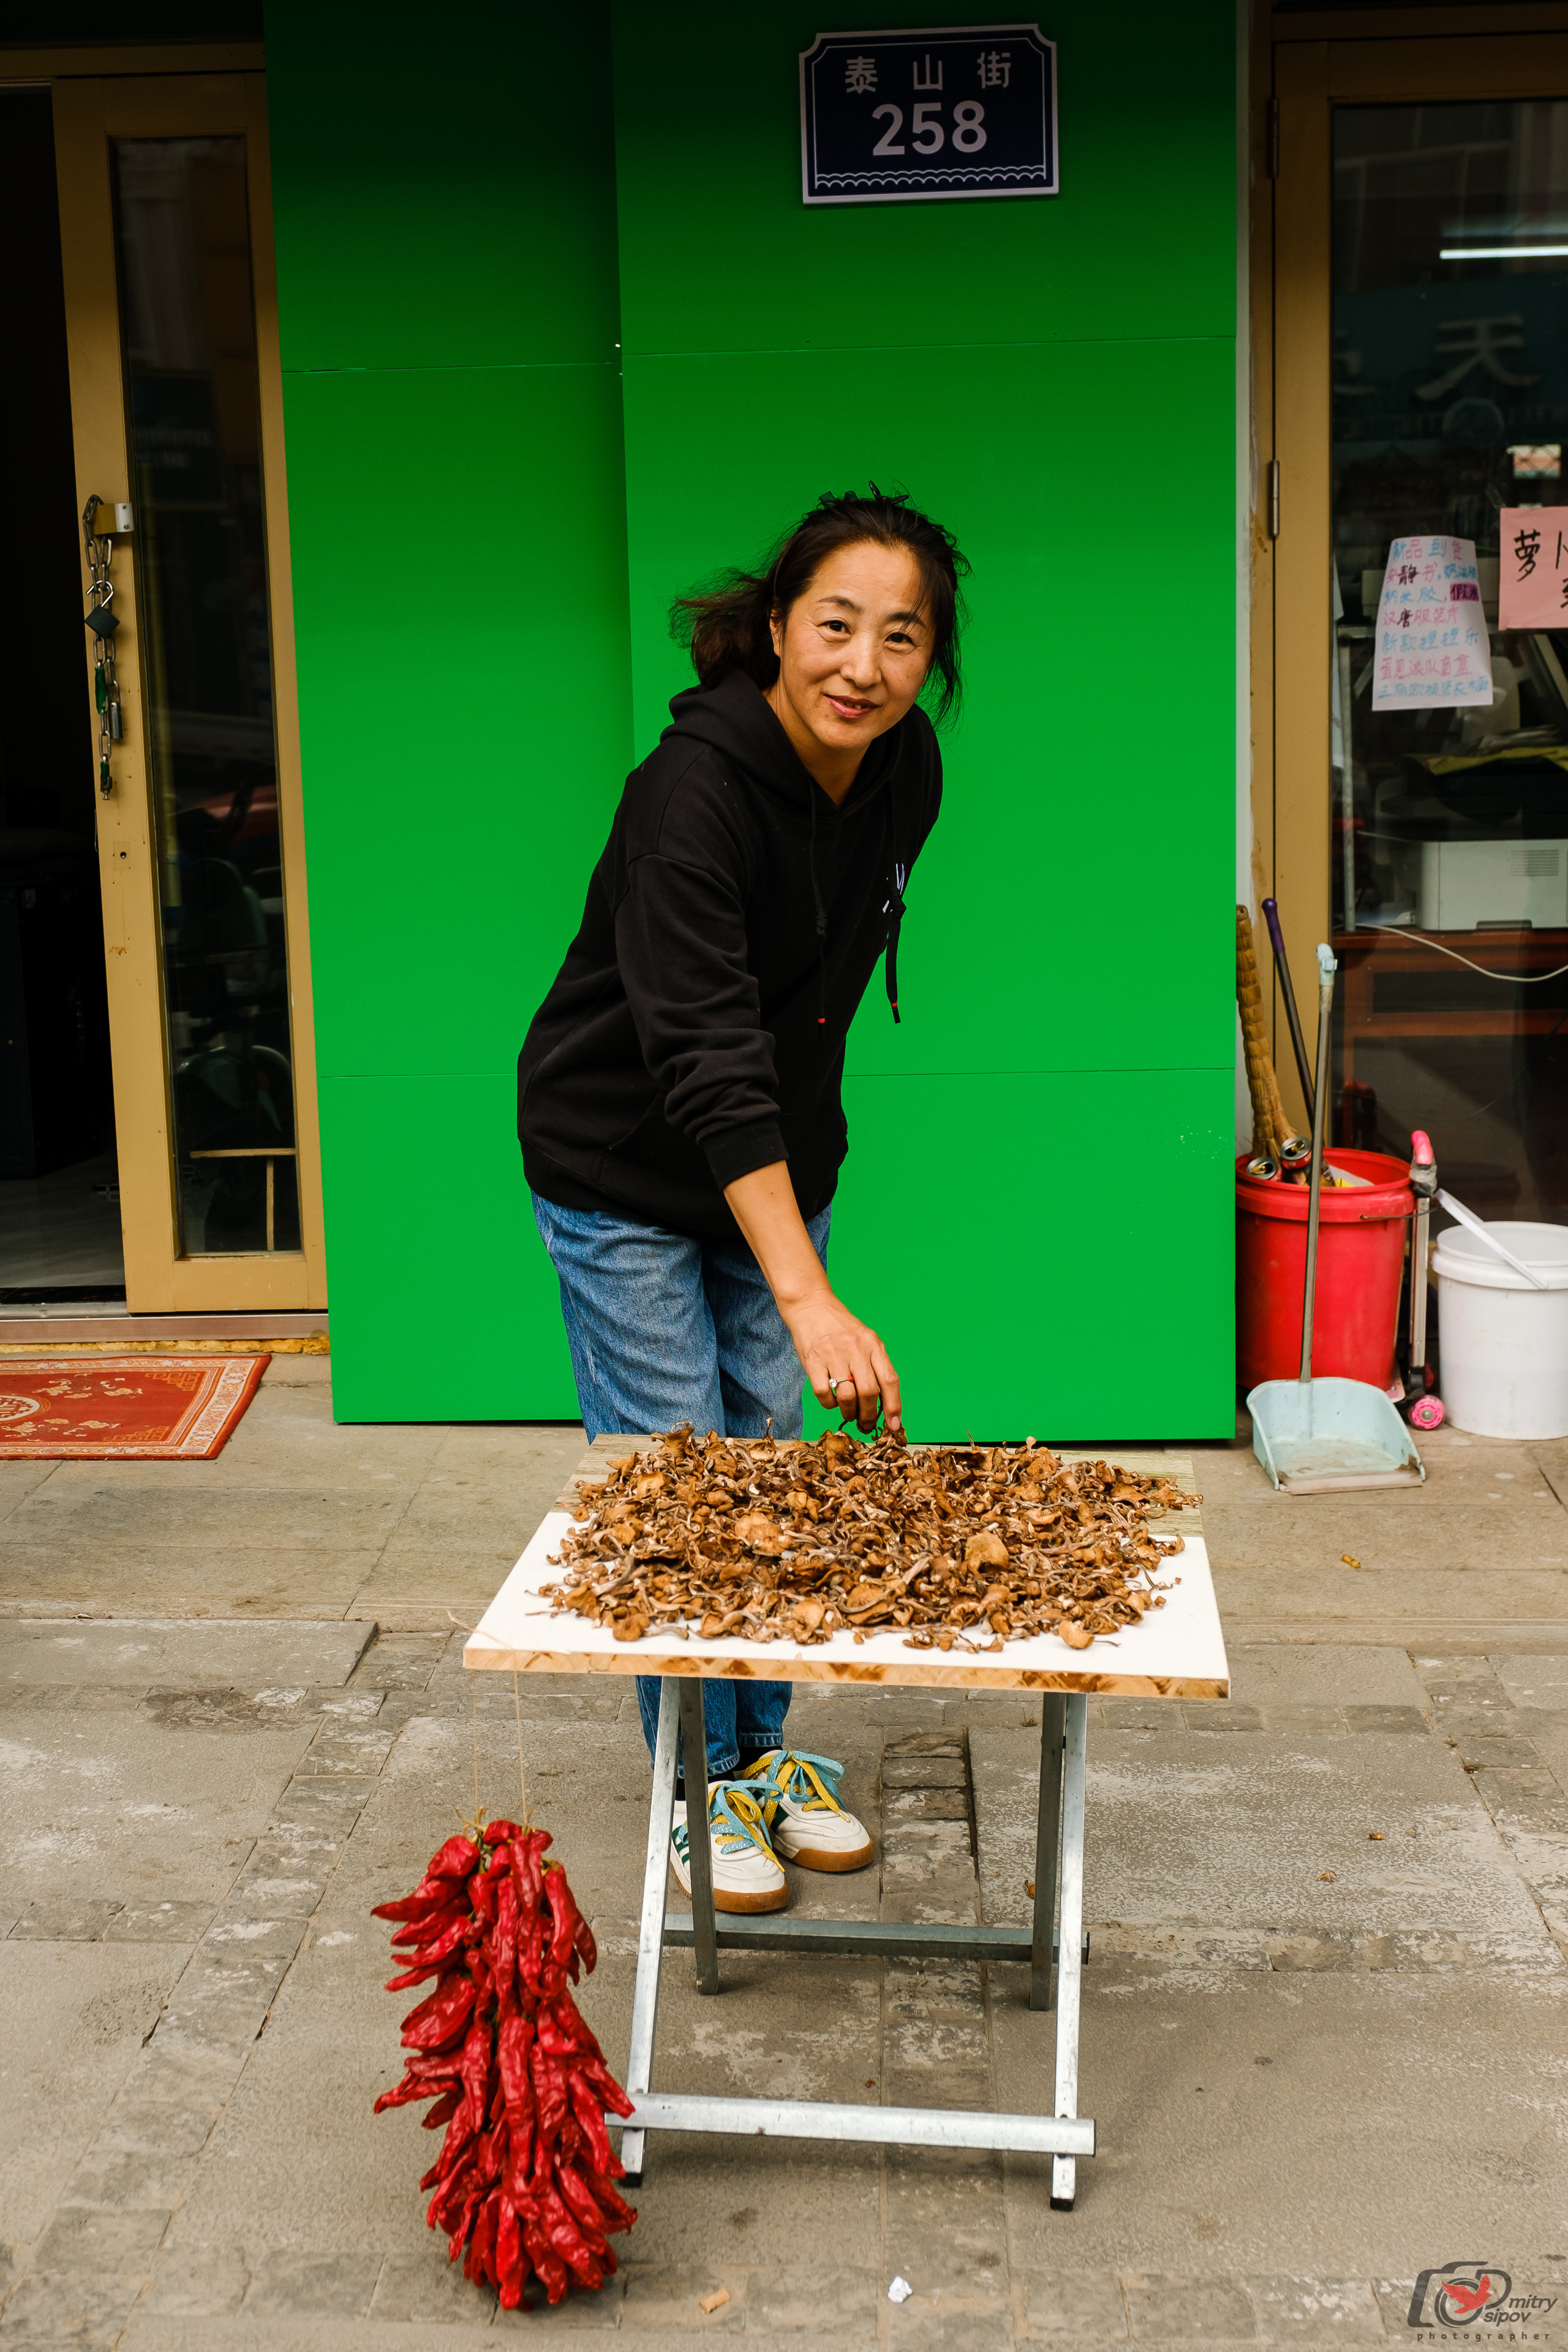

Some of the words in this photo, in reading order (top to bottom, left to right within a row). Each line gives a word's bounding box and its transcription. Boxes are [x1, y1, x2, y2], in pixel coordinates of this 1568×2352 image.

[845, 51, 1011, 94] 泰山街
[872, 100, 987, 156] 258
